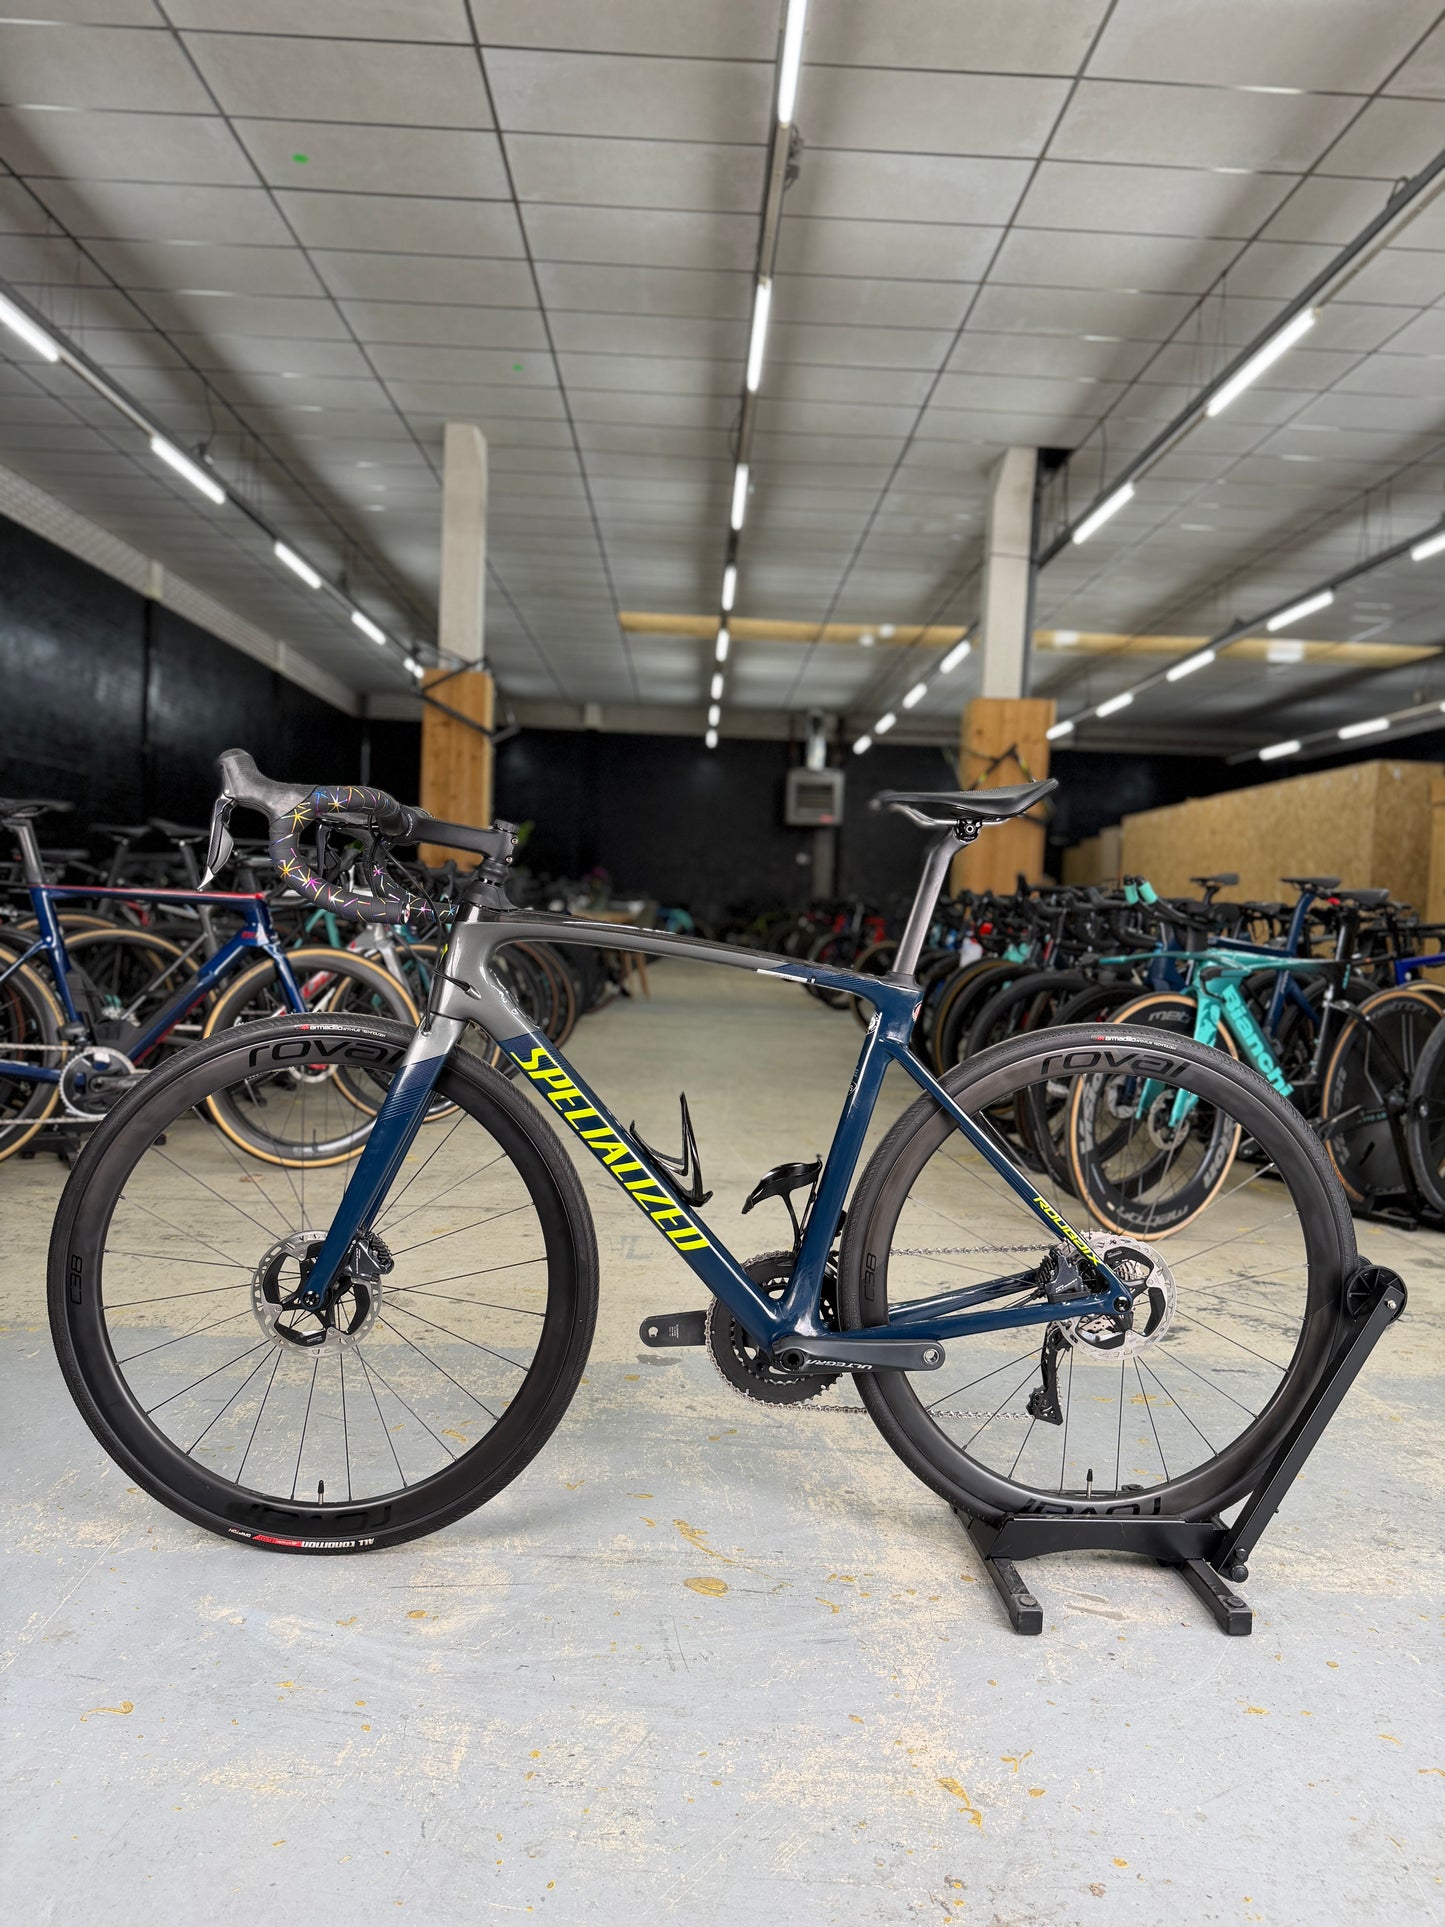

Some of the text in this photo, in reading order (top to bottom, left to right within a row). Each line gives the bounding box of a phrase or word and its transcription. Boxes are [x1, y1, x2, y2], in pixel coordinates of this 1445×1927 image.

[309, 1023, 343, 1031] armadillo
[1222, 984, 1294, 1097] Bianchi
[249, 1040, 408, 1067] roval
[1041, 1051, 1191, 1078] roval
[510, 1047, 710, 1251] SPECIALIZED
[70, 1254, 83, 1305] C38
[864, 1252, 877, 1302] C38
[806, 1359, 873, 1370] ULTEGRA
[301, 1540, 356, 1549] CONDITION
